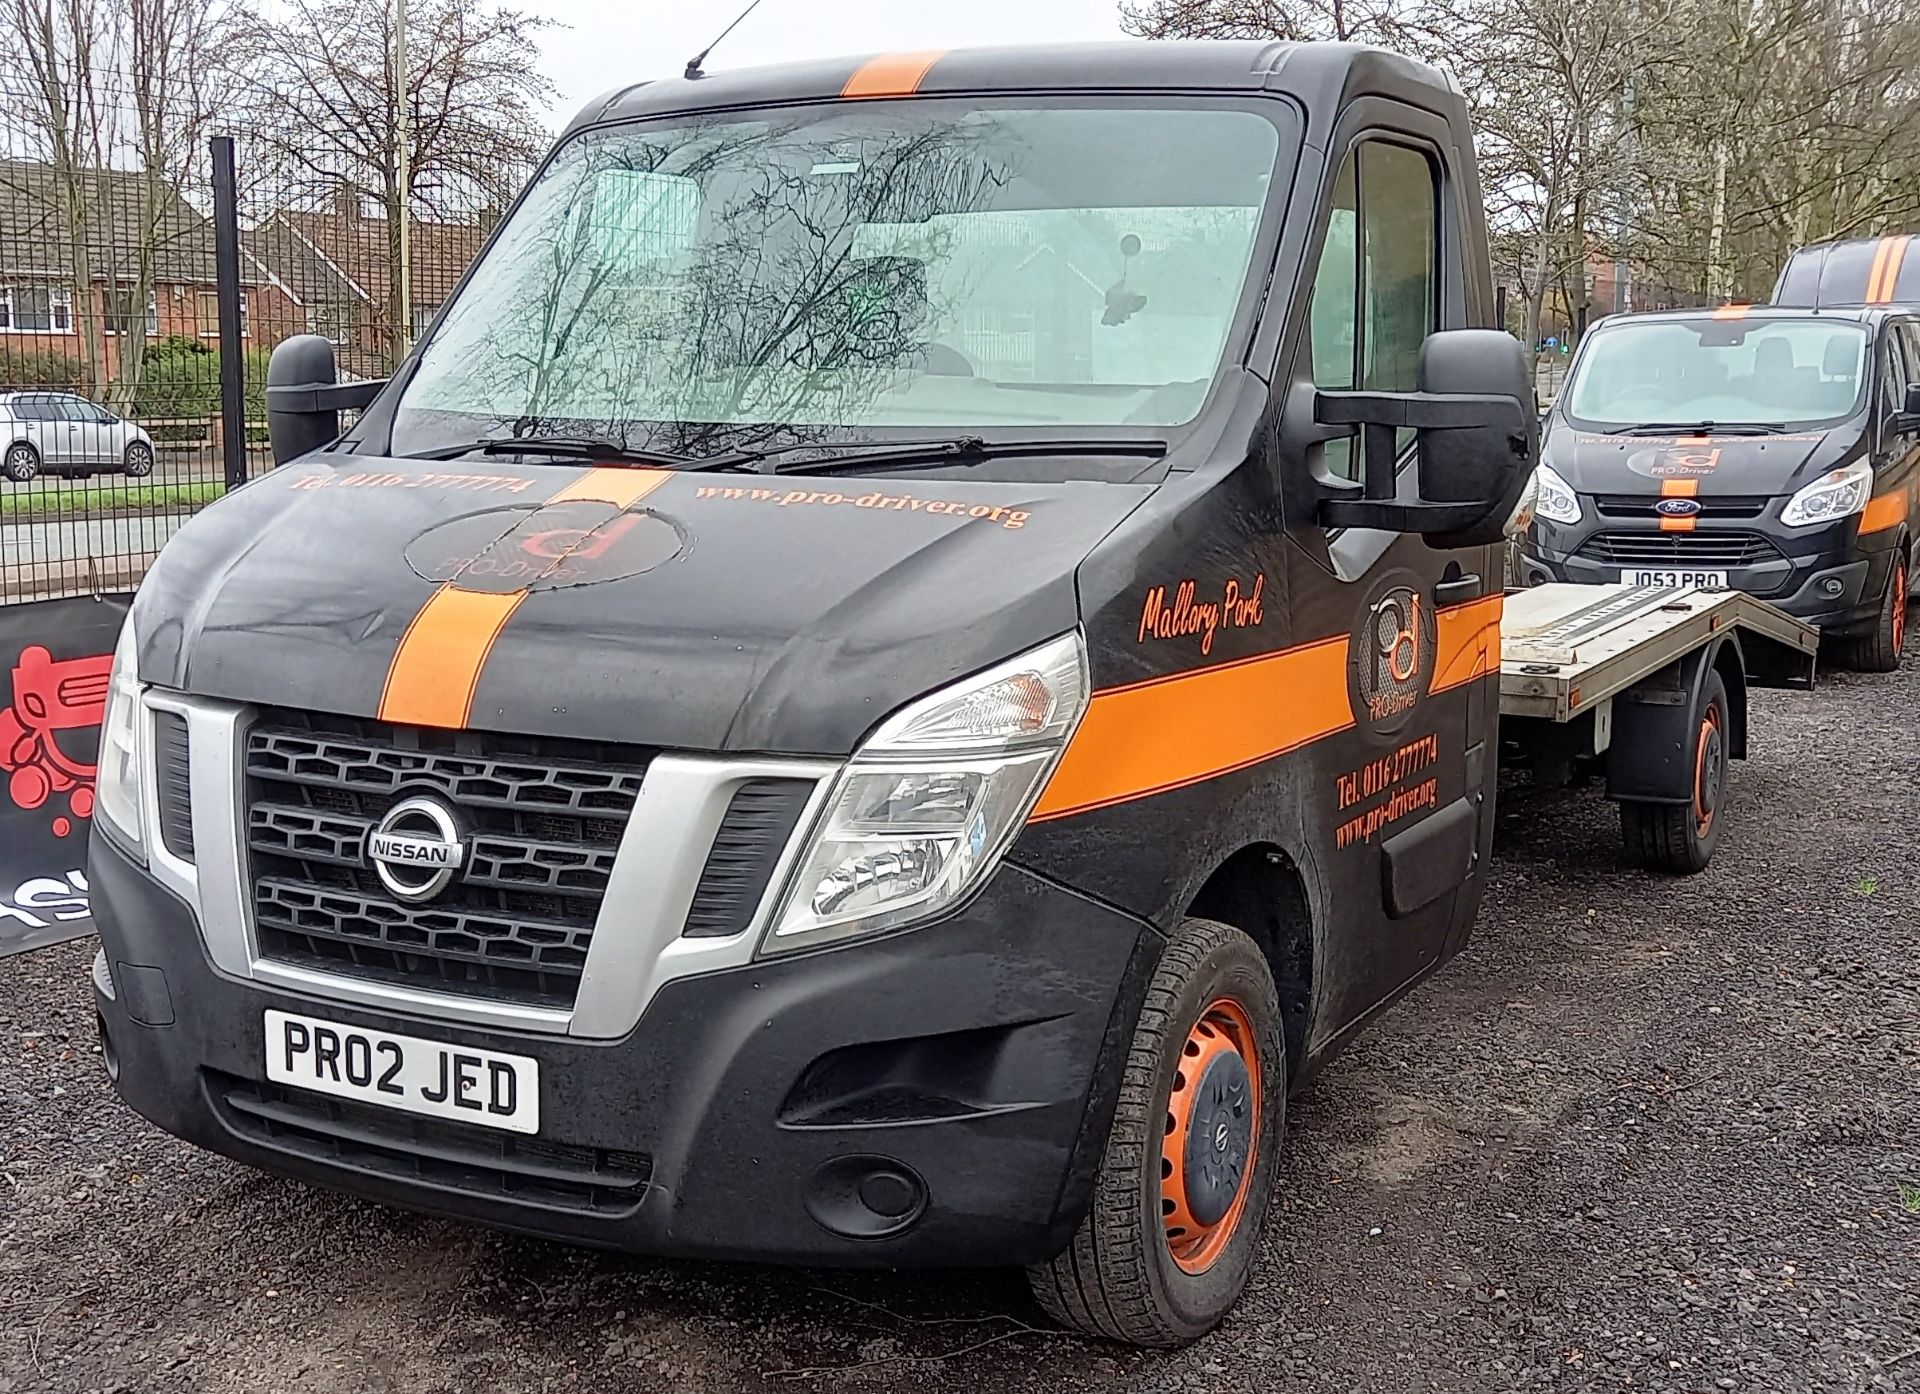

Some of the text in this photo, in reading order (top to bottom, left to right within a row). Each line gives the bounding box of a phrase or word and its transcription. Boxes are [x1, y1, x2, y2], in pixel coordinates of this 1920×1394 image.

[289, 473, 338, 490] Tel.
[338, 473, 408, 488] 0116
[1650, 466, 1717, 475] PRO-Driver
[695, 486, 1032, 530] www.pro-driver.org
[1664, 501, 1692, 512] Ford
[1681, 573, 1719, 589] PRO
[1137, 573, 1264, 656] Mallory Park
[1369, 690, 1418, 722] PRO-Driver
[1336, 732, 1437, 811] Tel. 0116 2777774
[1335, 778, 1437, 851] www.pro-driver.org
[373, 839, 448, 863] NISSAN
[420, 1050, 517, 1117] JED
